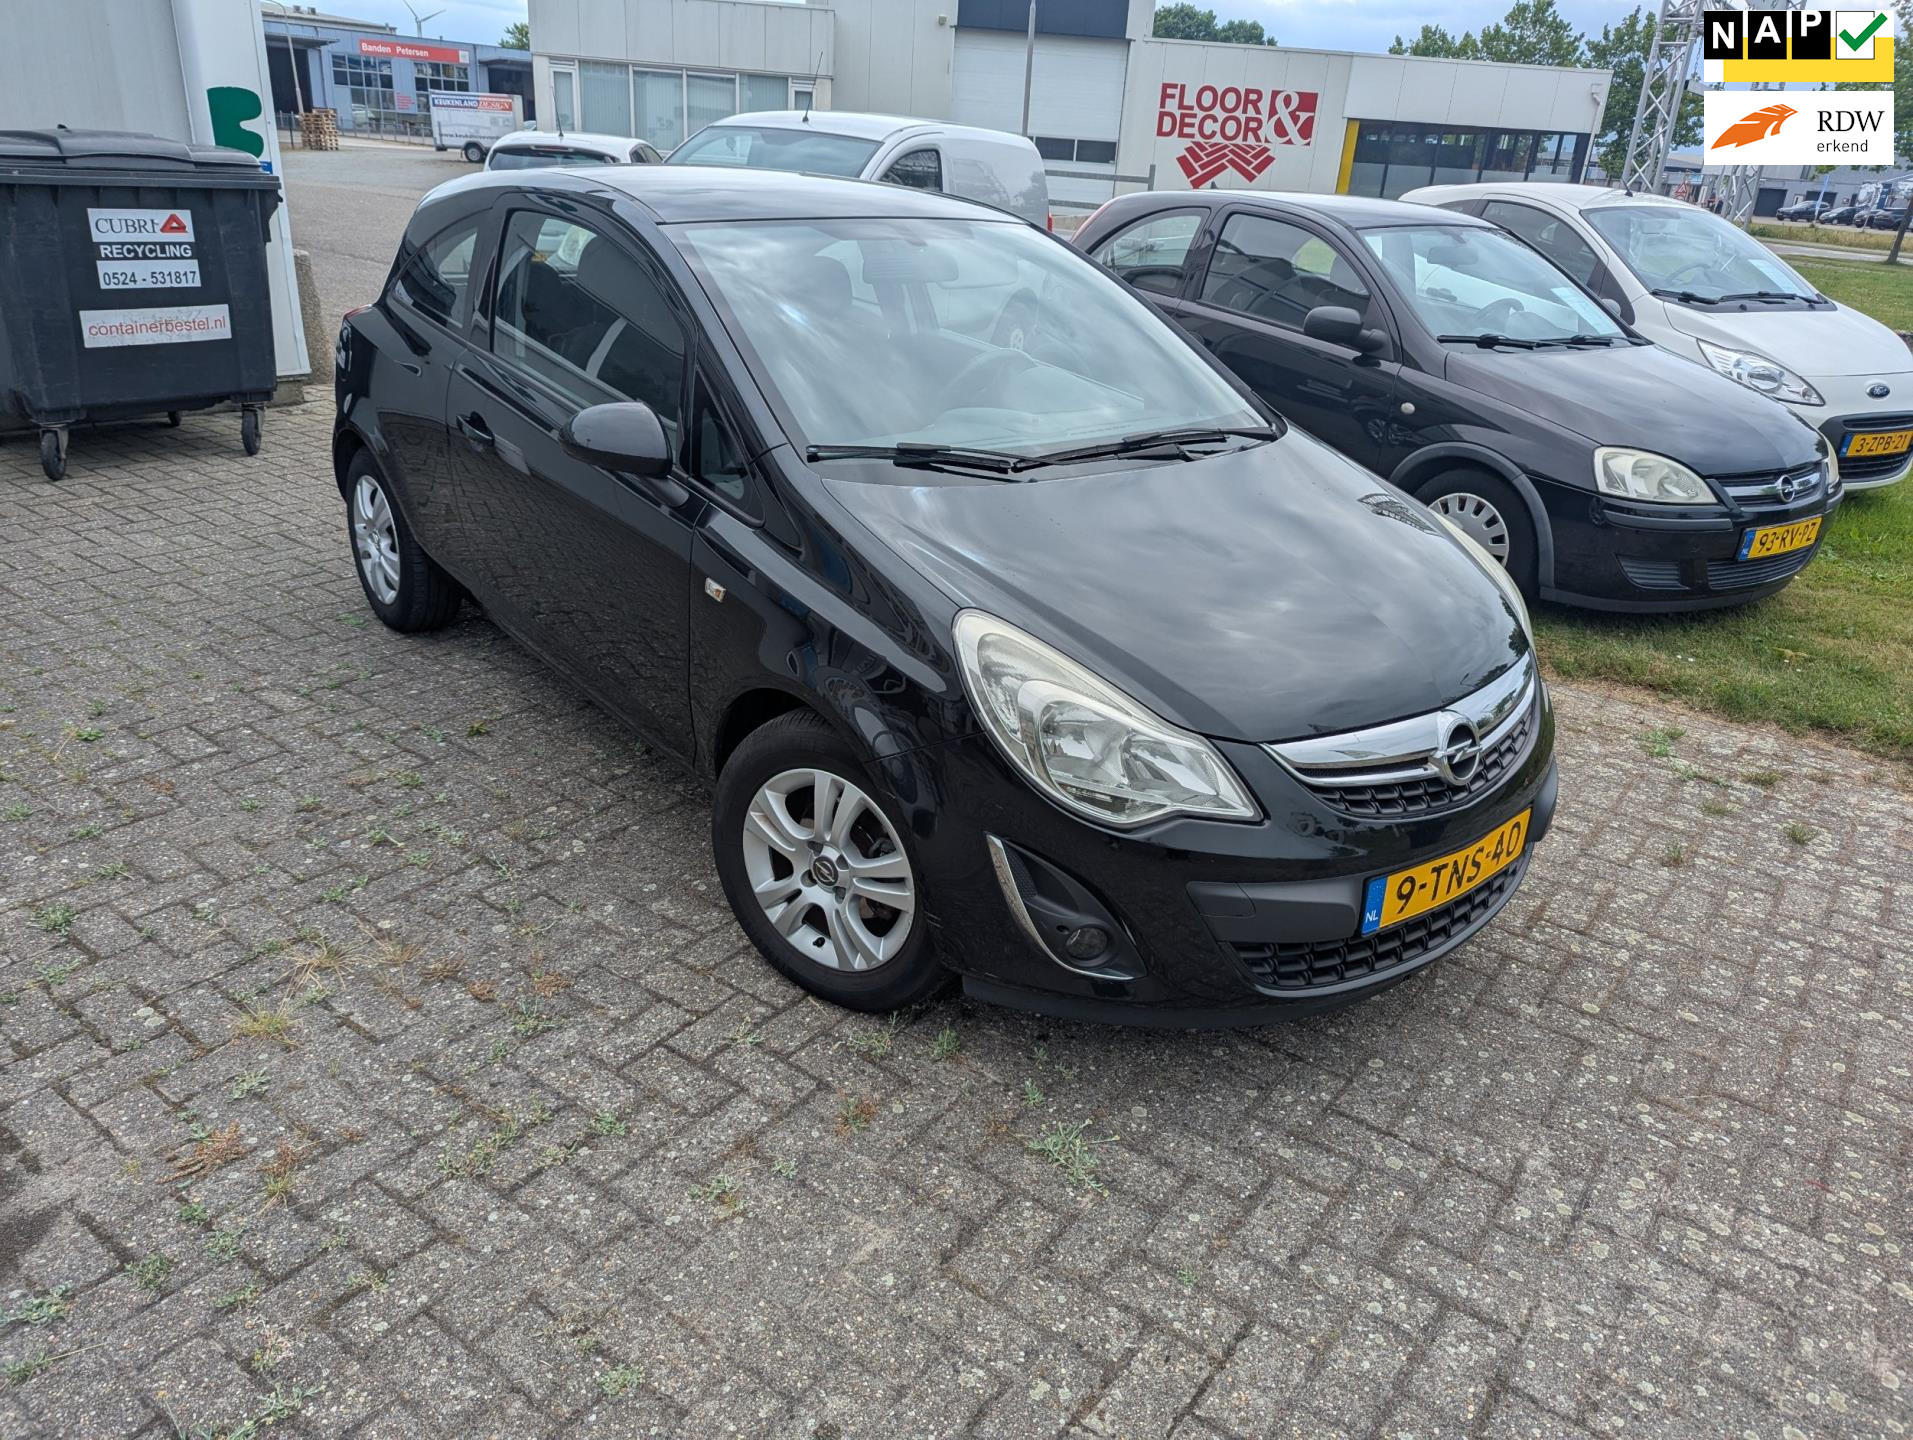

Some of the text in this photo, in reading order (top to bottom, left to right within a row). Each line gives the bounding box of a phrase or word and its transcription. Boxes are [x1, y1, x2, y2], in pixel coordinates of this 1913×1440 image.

[361, 42, 429, 57] Banden Petersen
[434, 98, 479, 107] KEUKENLAND
[1159, 83, 1263, 115] FLOOR
[1156, 111, 1264, 142] DECOR
[100, 244, 193, 258] RECYCLING
[102, 271, 138, 286] 0524
[150, 270, 197, 285] 531817
[88, 316, 227, 336] containerbestel.nl
[1855, 434, 1908, 453] 3-ZPB-21
[1757, 522, 1817, 553] 93-RV-PZ
[1397, 821, 1521, 914] 9-TNS-40
[1365, 909, 1379, 923] NL
